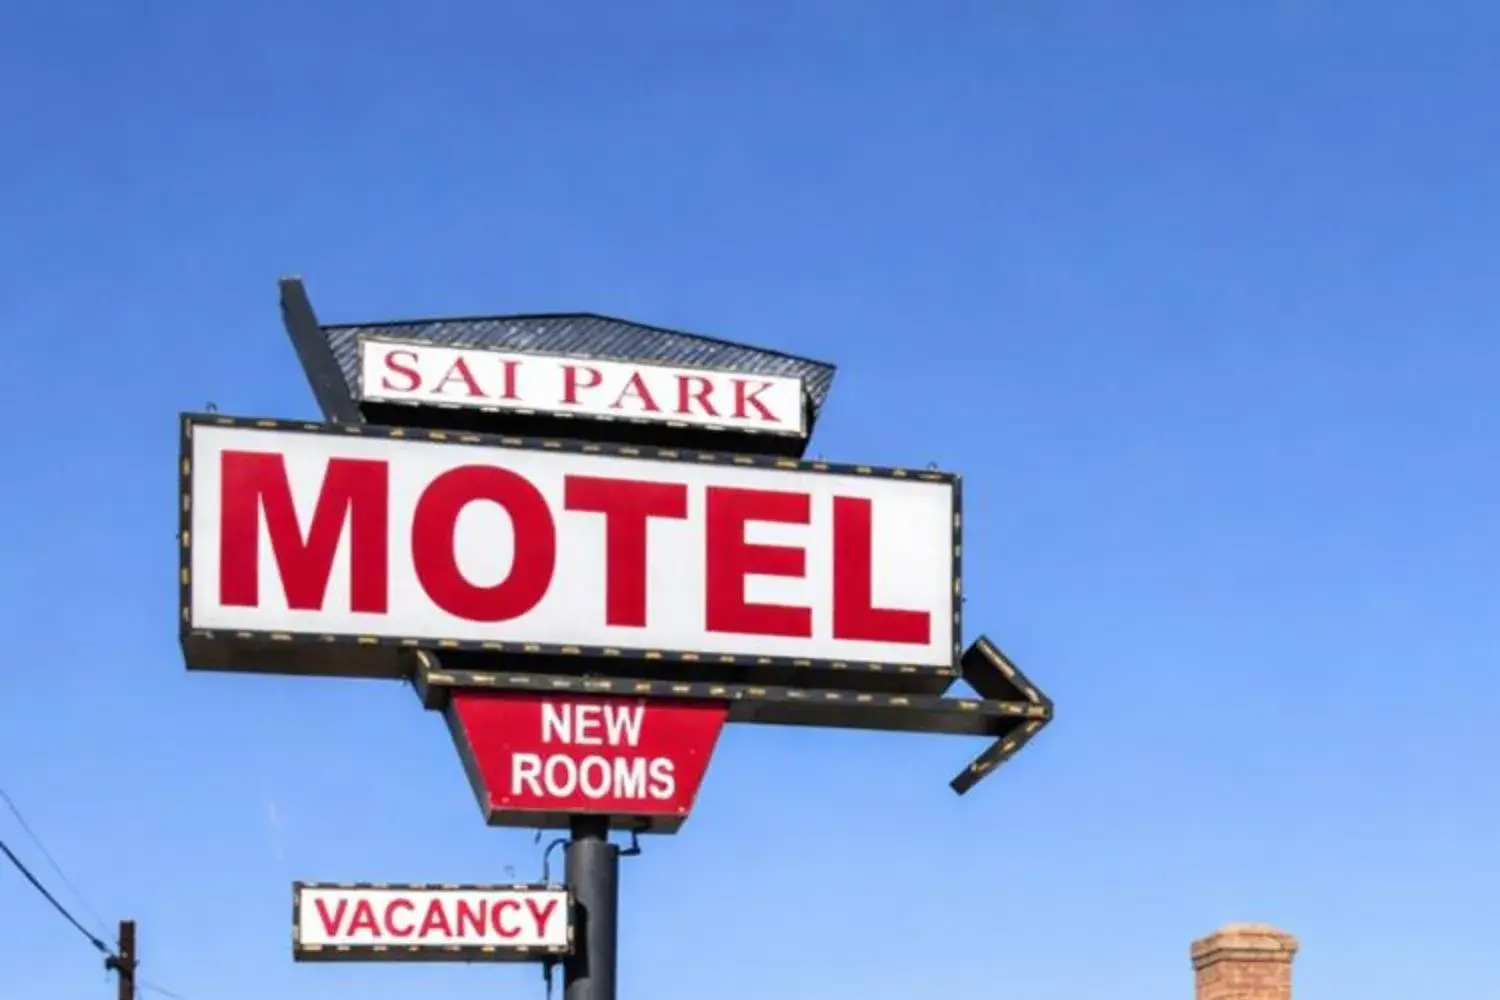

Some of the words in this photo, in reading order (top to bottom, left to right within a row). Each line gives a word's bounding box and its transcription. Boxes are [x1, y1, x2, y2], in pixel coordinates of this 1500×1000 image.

[381, 350, 522, 400] SAI
[562, 365, 783, 422] PARK
[218, 449, 932, 646] MOTEL
[541, 702, 646, 748] NEW
[510, 752, 677, 801] ROOMS
[313, 895, 560, 940] VACANCY
